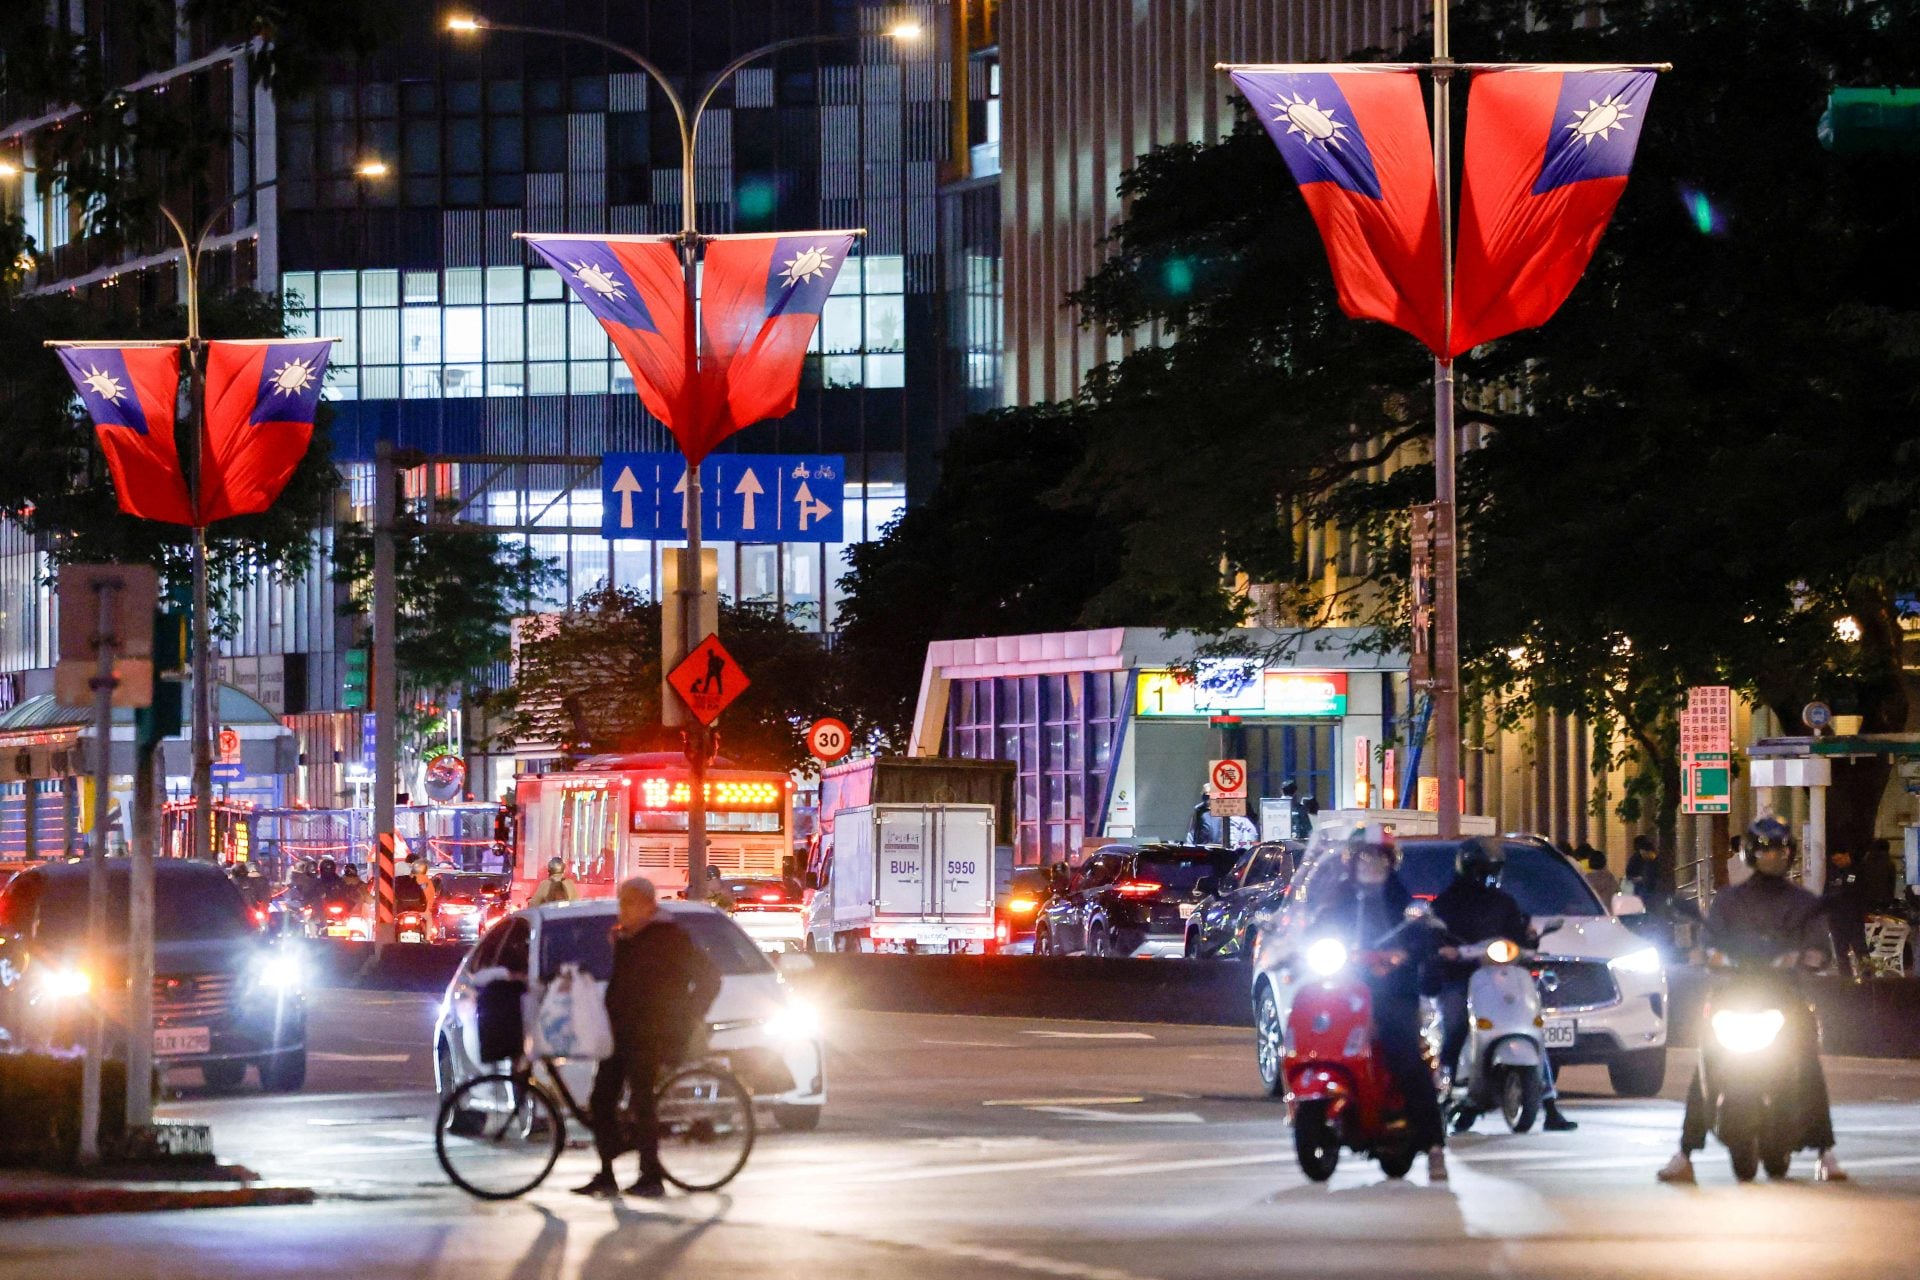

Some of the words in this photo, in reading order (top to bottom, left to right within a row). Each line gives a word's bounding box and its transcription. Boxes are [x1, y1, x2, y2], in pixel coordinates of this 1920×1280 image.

[1153, 687, 1163, 711] 1
[819, 733, 840, 748] 30
[890, 860, 919, 874] BUH-
[947, 861, 975, 874] 5950
